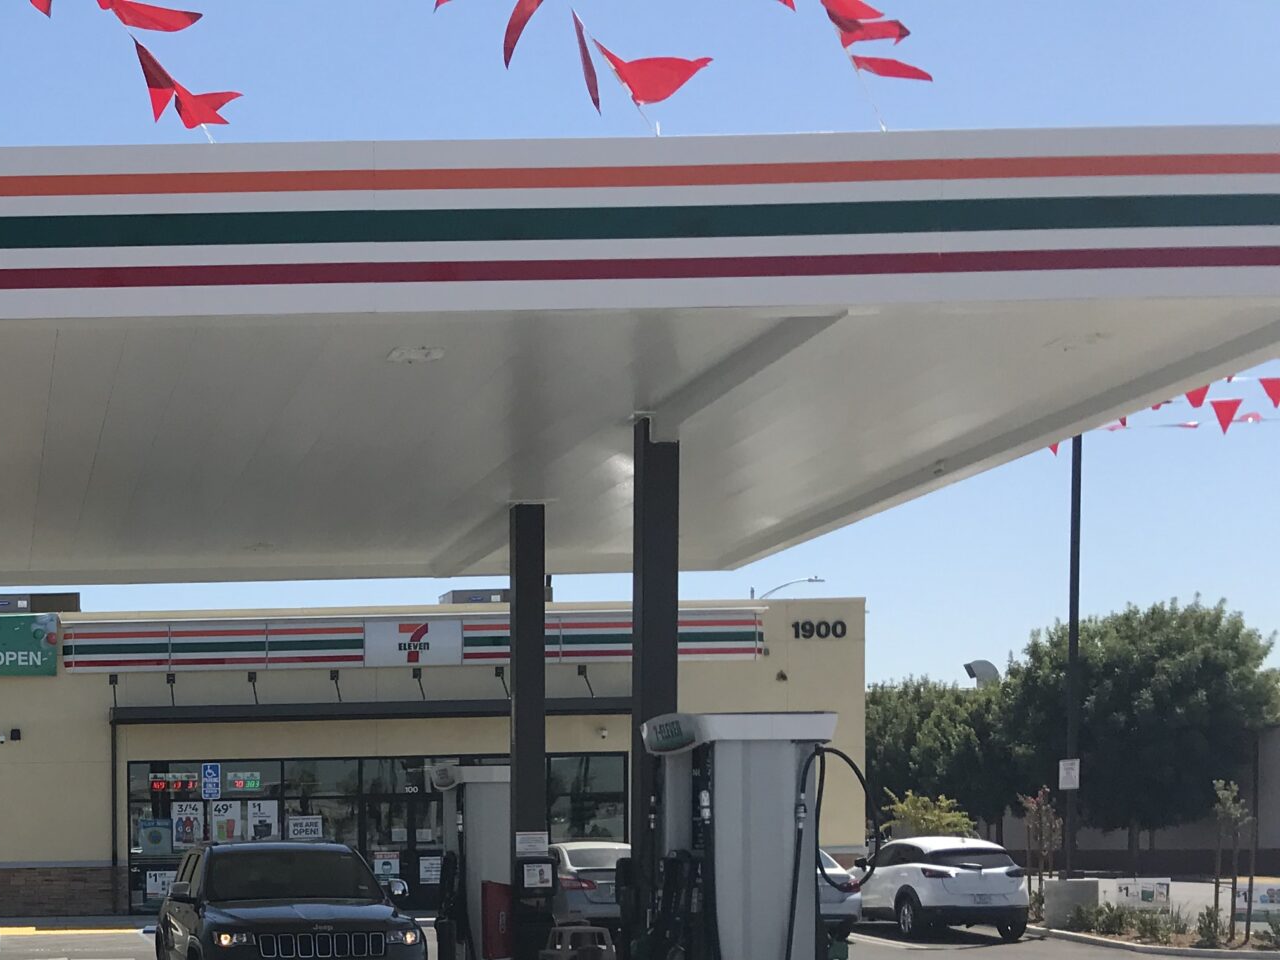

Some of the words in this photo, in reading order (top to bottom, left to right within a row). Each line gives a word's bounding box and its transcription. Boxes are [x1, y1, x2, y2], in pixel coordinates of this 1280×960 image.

[791, 620, 847, 639] 1900
[399, 623, 428, 663] 7
[177, 803, 199, 813] 3/$4
[252, 802, 261, 812] $1
[292, 828, 319, 836] OPEN!
[148, 872, 158, 883] $1
[1118, 886, 1130, 897] $1
[313, 923, 334, 931] Jeep
